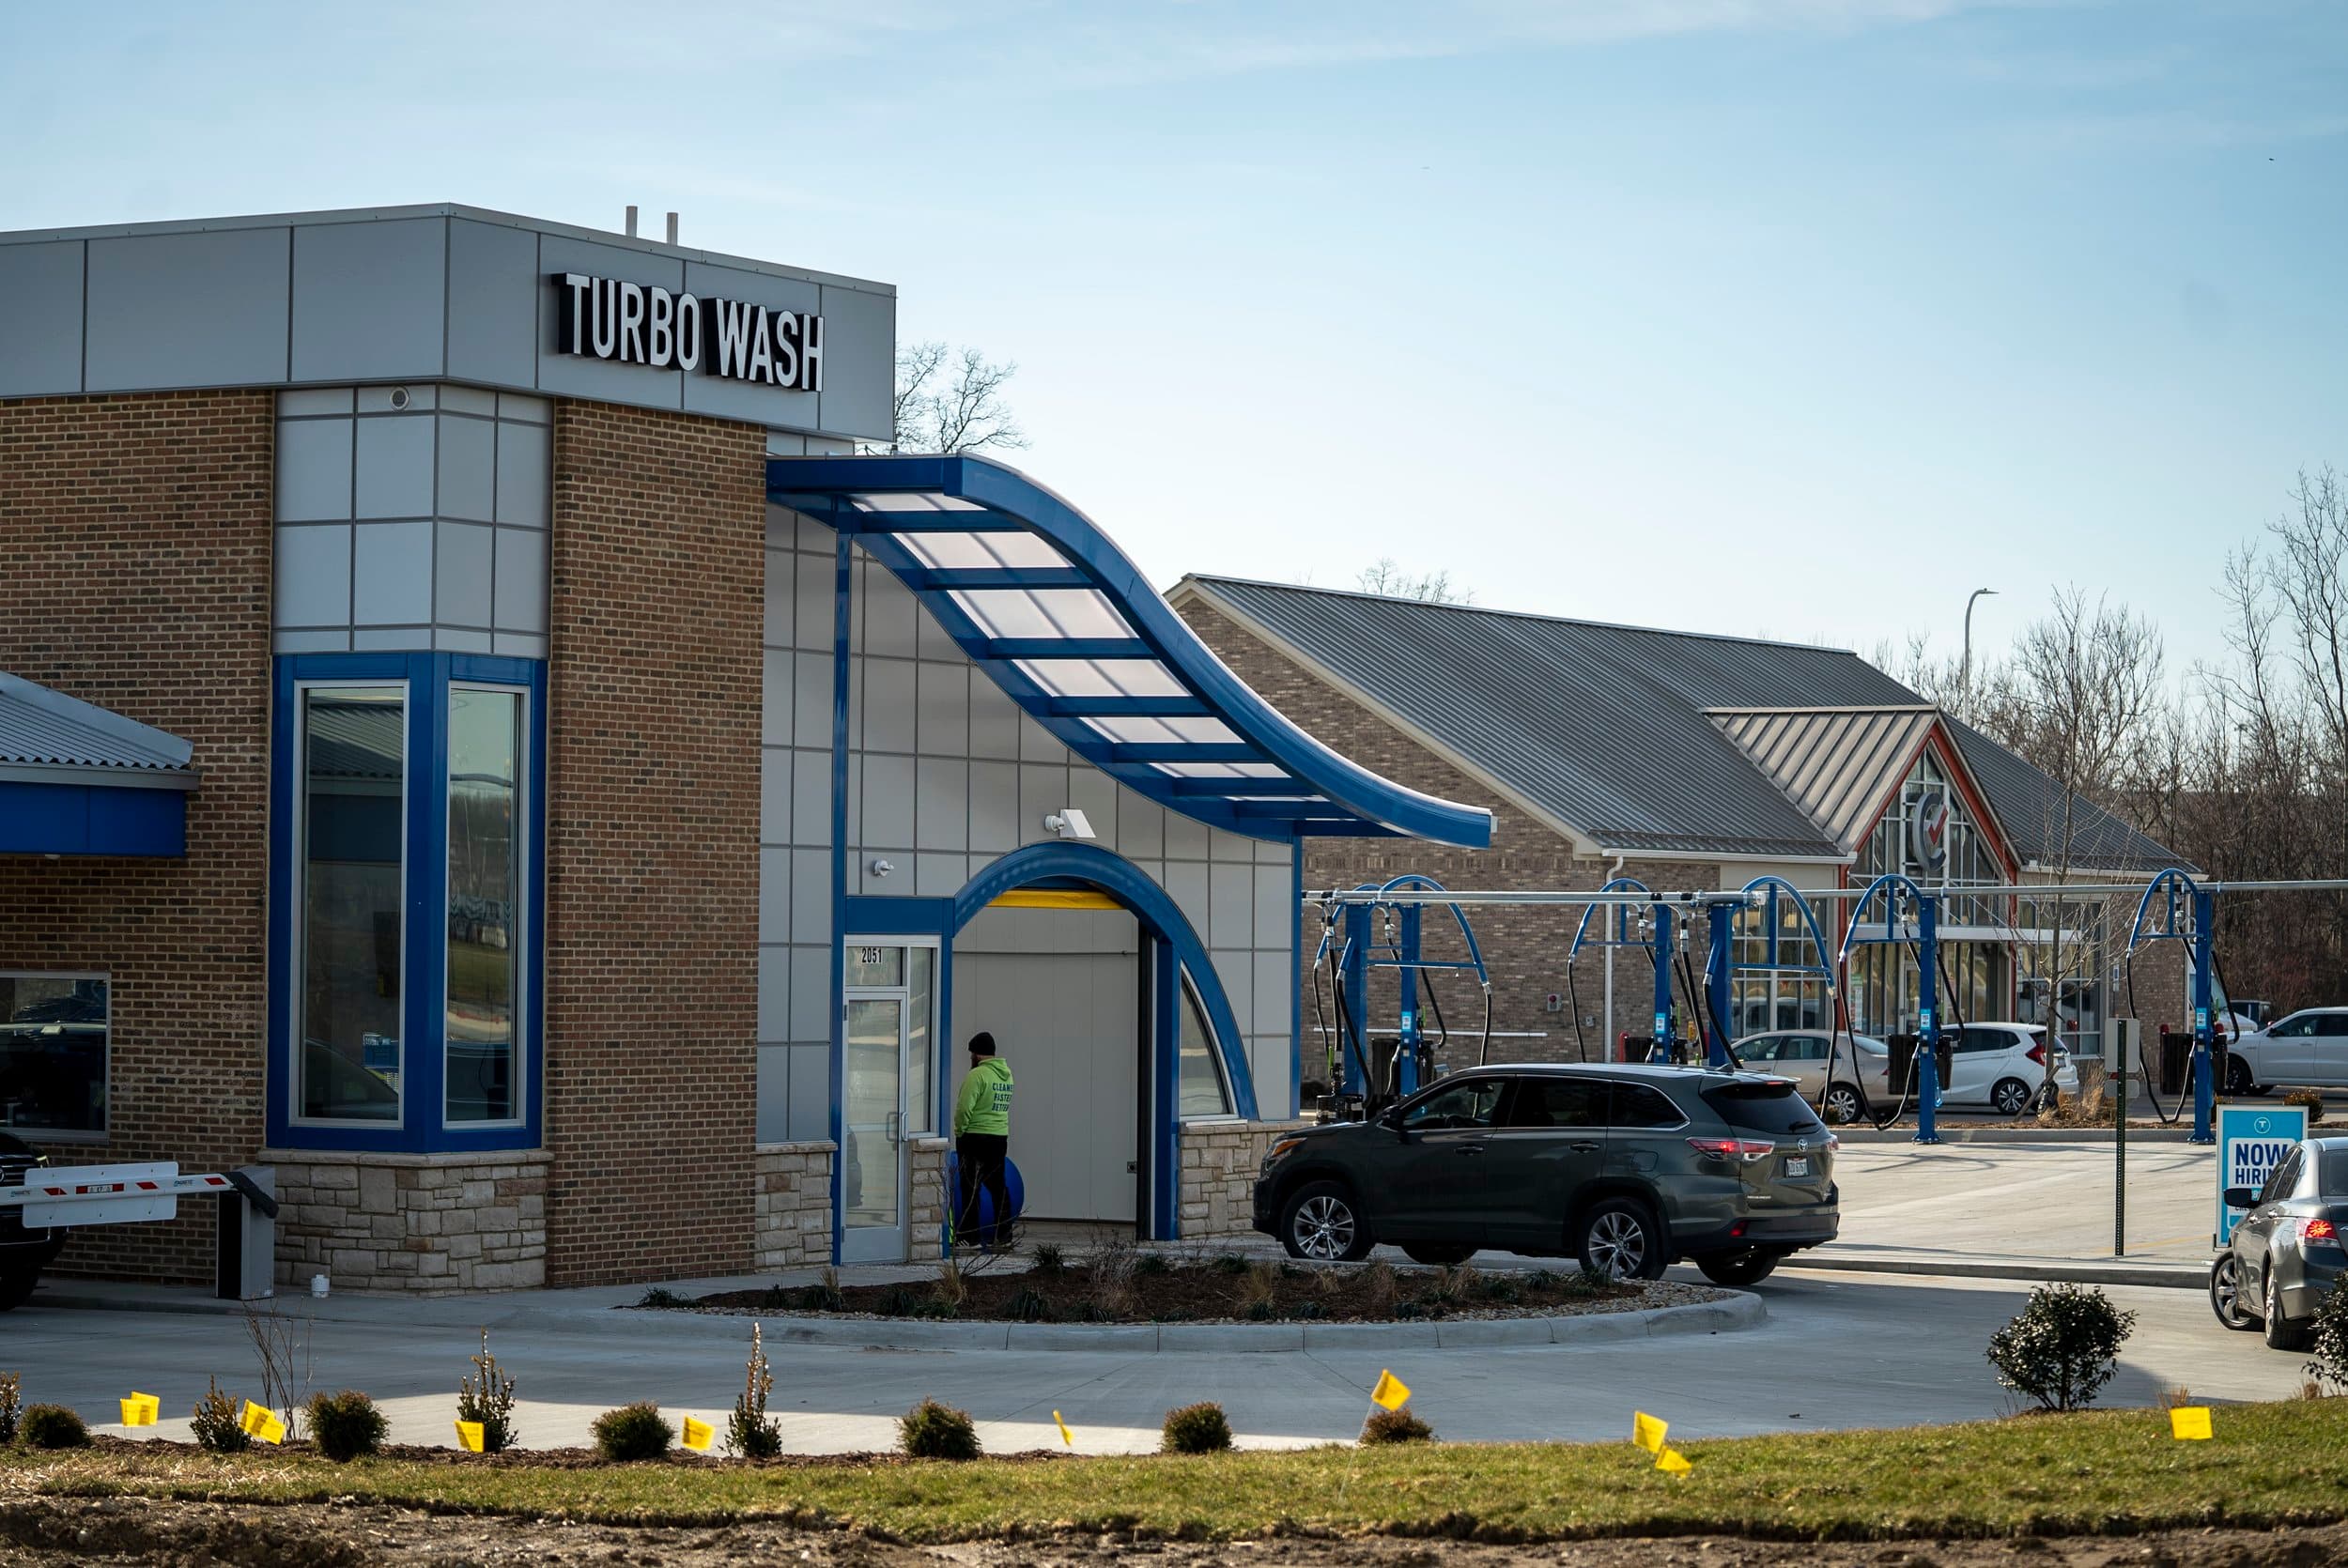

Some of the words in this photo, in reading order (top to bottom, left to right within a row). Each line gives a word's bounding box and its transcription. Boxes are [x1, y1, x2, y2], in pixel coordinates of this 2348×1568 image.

[564, 272, 701, 372] TURBO
[714, 298, 826, 392] WASH
[861, 947, 882, 963] 2051
[992, 1082, 1014, 1092] CLEANE
[994, 1093, 1012, 1102] FASTE
[2235, 1144, 2288, 1166] NOW
[2235, 1168, 2274, 1184] HIRI
